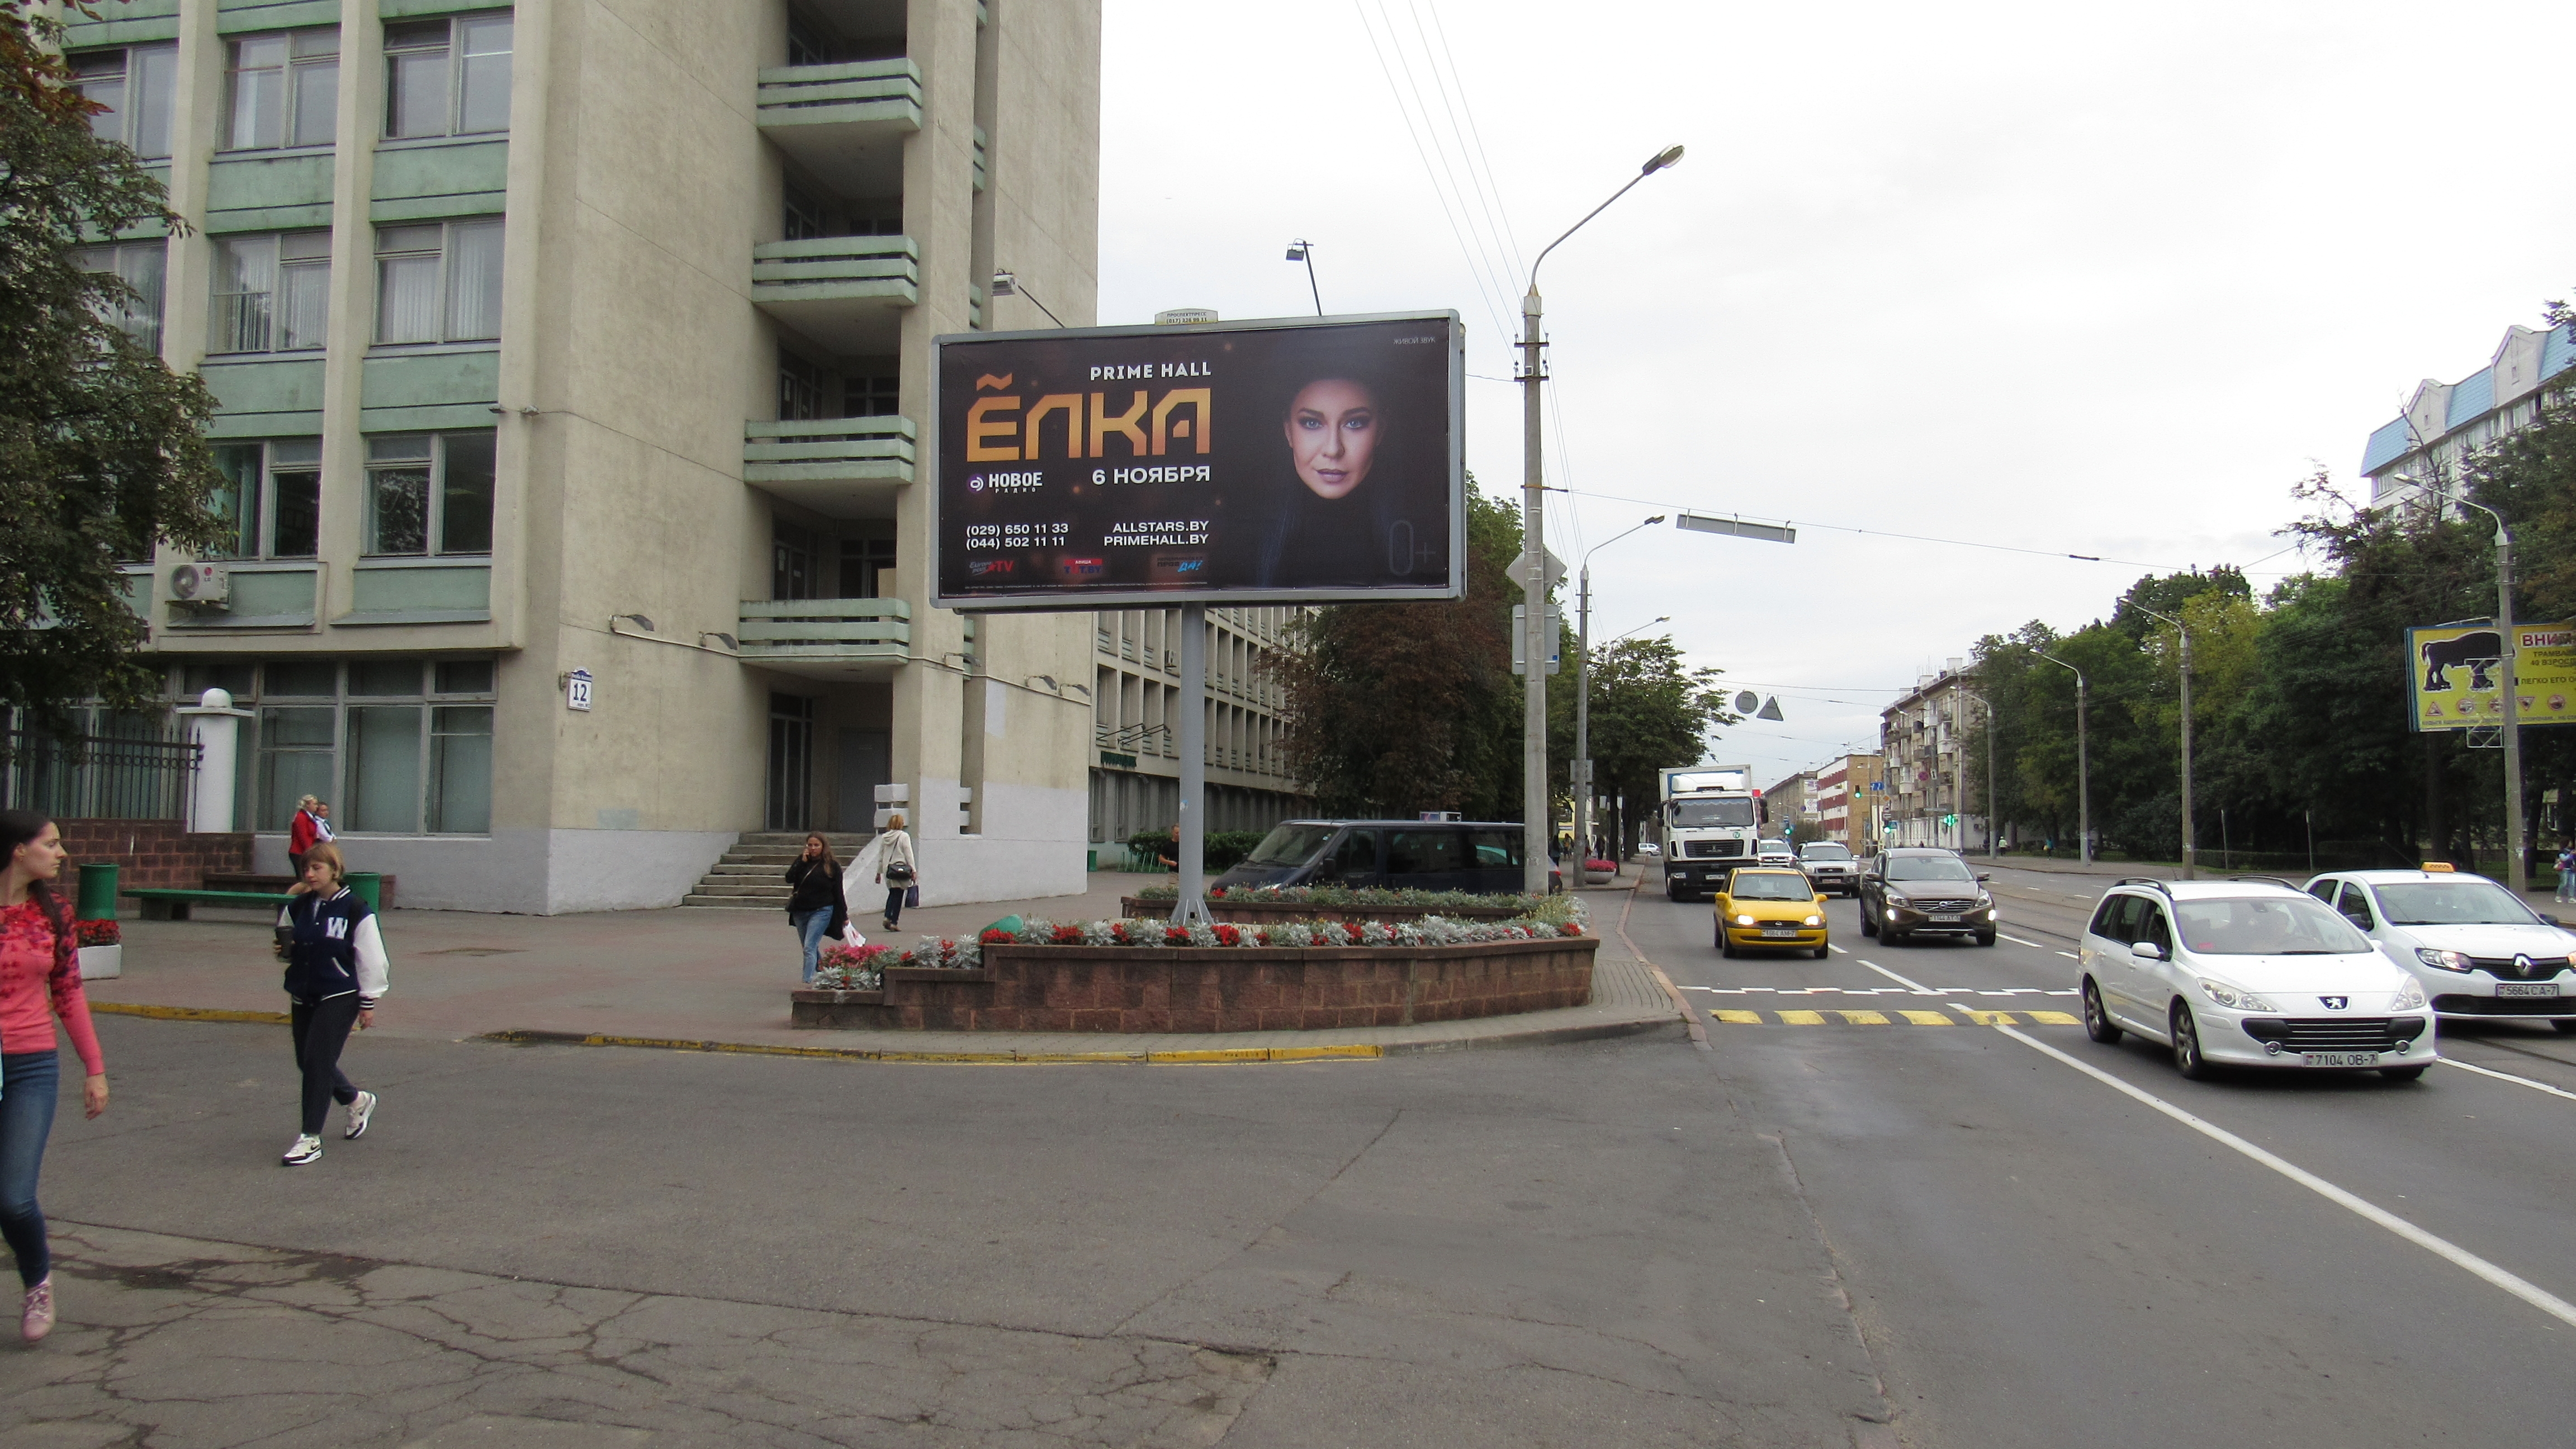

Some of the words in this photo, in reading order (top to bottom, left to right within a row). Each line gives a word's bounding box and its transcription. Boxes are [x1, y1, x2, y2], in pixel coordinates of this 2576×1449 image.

[1090, 364, 1153, 381] PRIME
[1161, 362, 1211, 378] HALL
[988, 472, 1043, 488] НОВОЕ
[1092, 470, 1106, 485] 6
[1114, 466, 1210, 484] НОЯБРЯ
[966, 524, 1001, 538] (029)
[1005, 524, 1030, 535] 650
[1034, 524, 1047, 534] 11
[1052, 523, 1069, 533] 33
[1112, 520, 1209, 533] ALLSTARS.BY
[966, 537, 1001, 551] (044)
[1005, 537, 1030, 548] 502
[1034, 537, 1046, 547] 11
[1052, 536, 1065, 546] 11
[1104, 534, 1209, 546] PRIMEHALL.BY
[996, 560, 1014, 572] TV
[574, 683, 587, 702] 12
[325, 917, 348, 940] W
[2506, 986, 2530, 995] 5664
[2531, 986, 2556, 995] CA-7
[2315, 1054, 2343, 1066] 7104
[2347, 1054, 2376, 1066] OB-7
